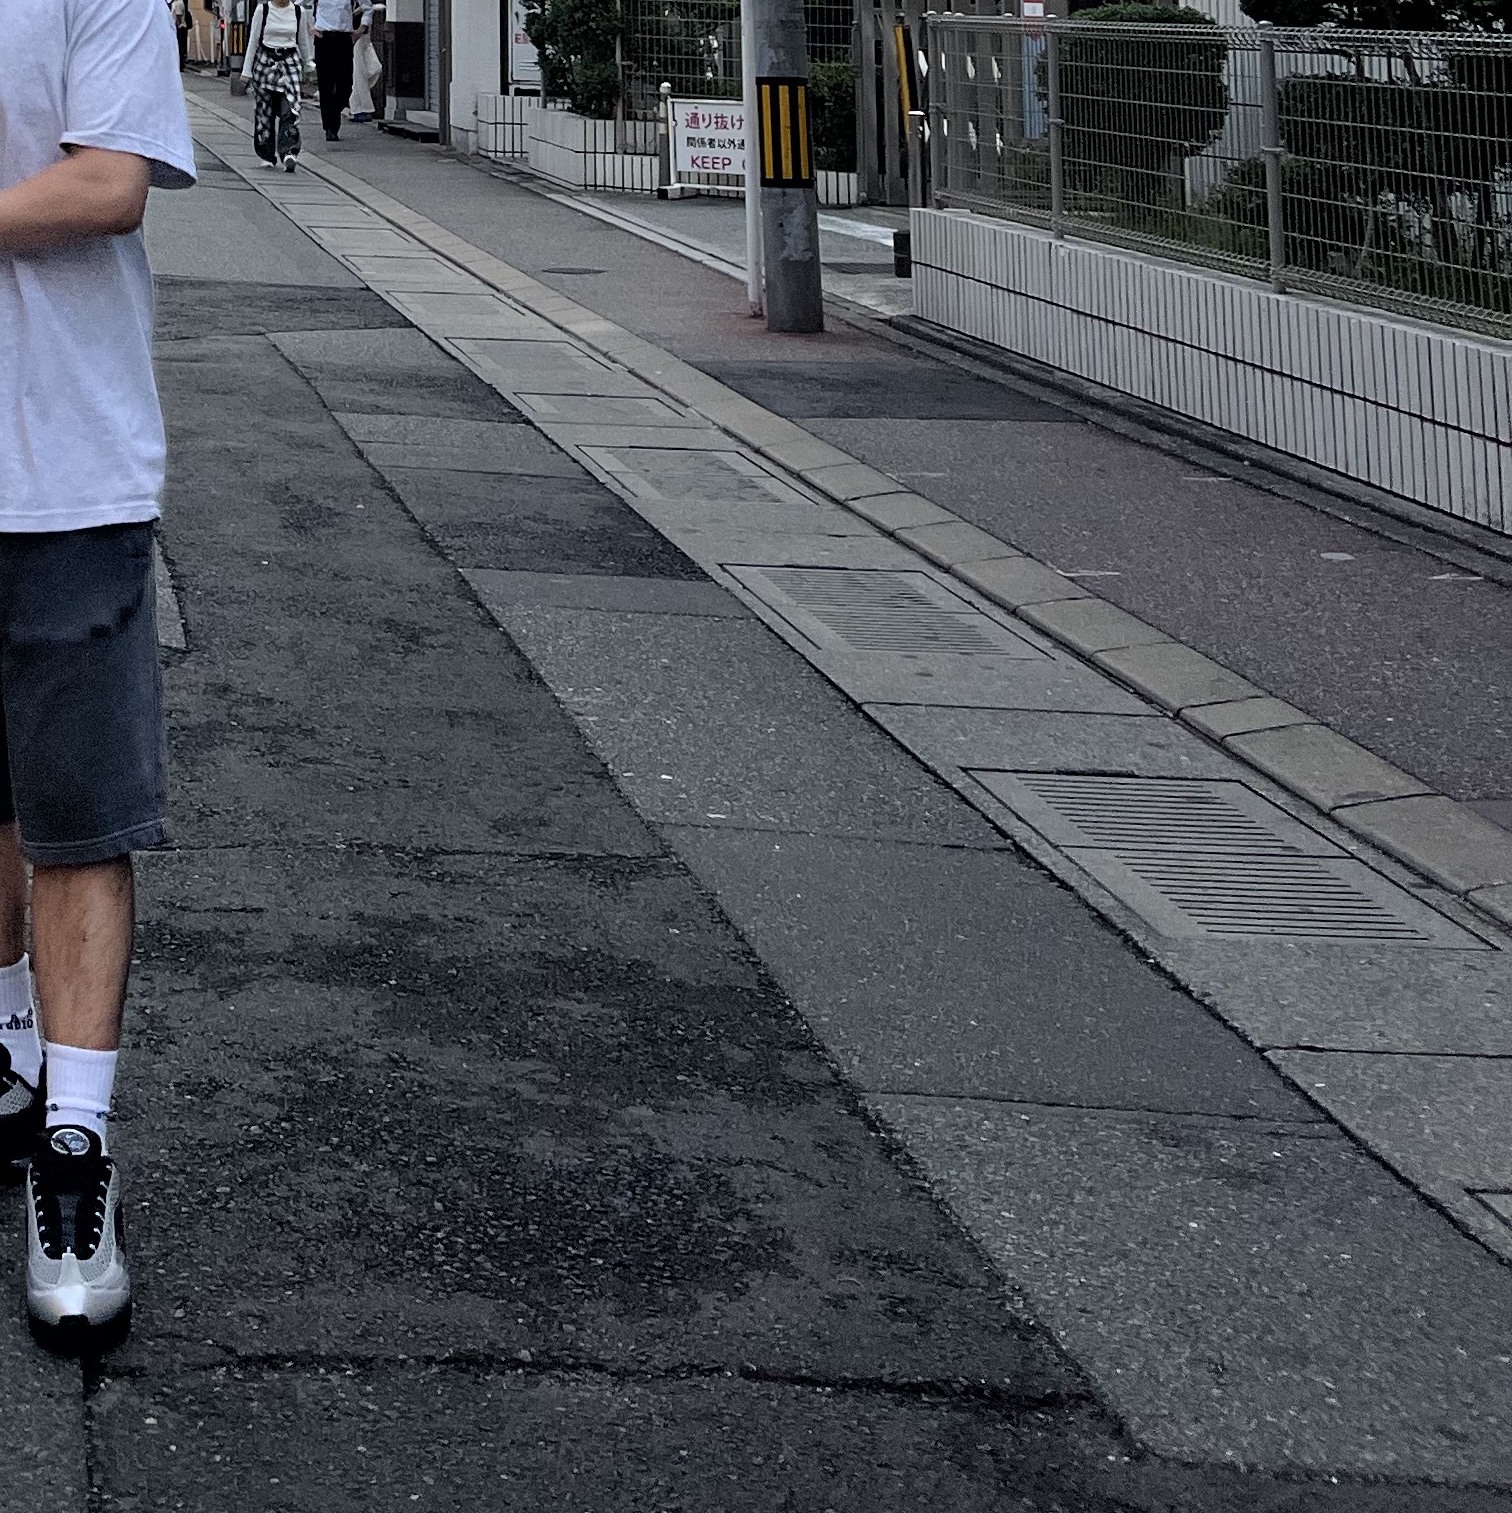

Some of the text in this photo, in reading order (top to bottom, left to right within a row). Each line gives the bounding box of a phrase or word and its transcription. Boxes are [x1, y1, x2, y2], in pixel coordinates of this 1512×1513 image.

[684, 112, 745, 130] 通り抜け
[690, 155, 732, 171] KEEP
